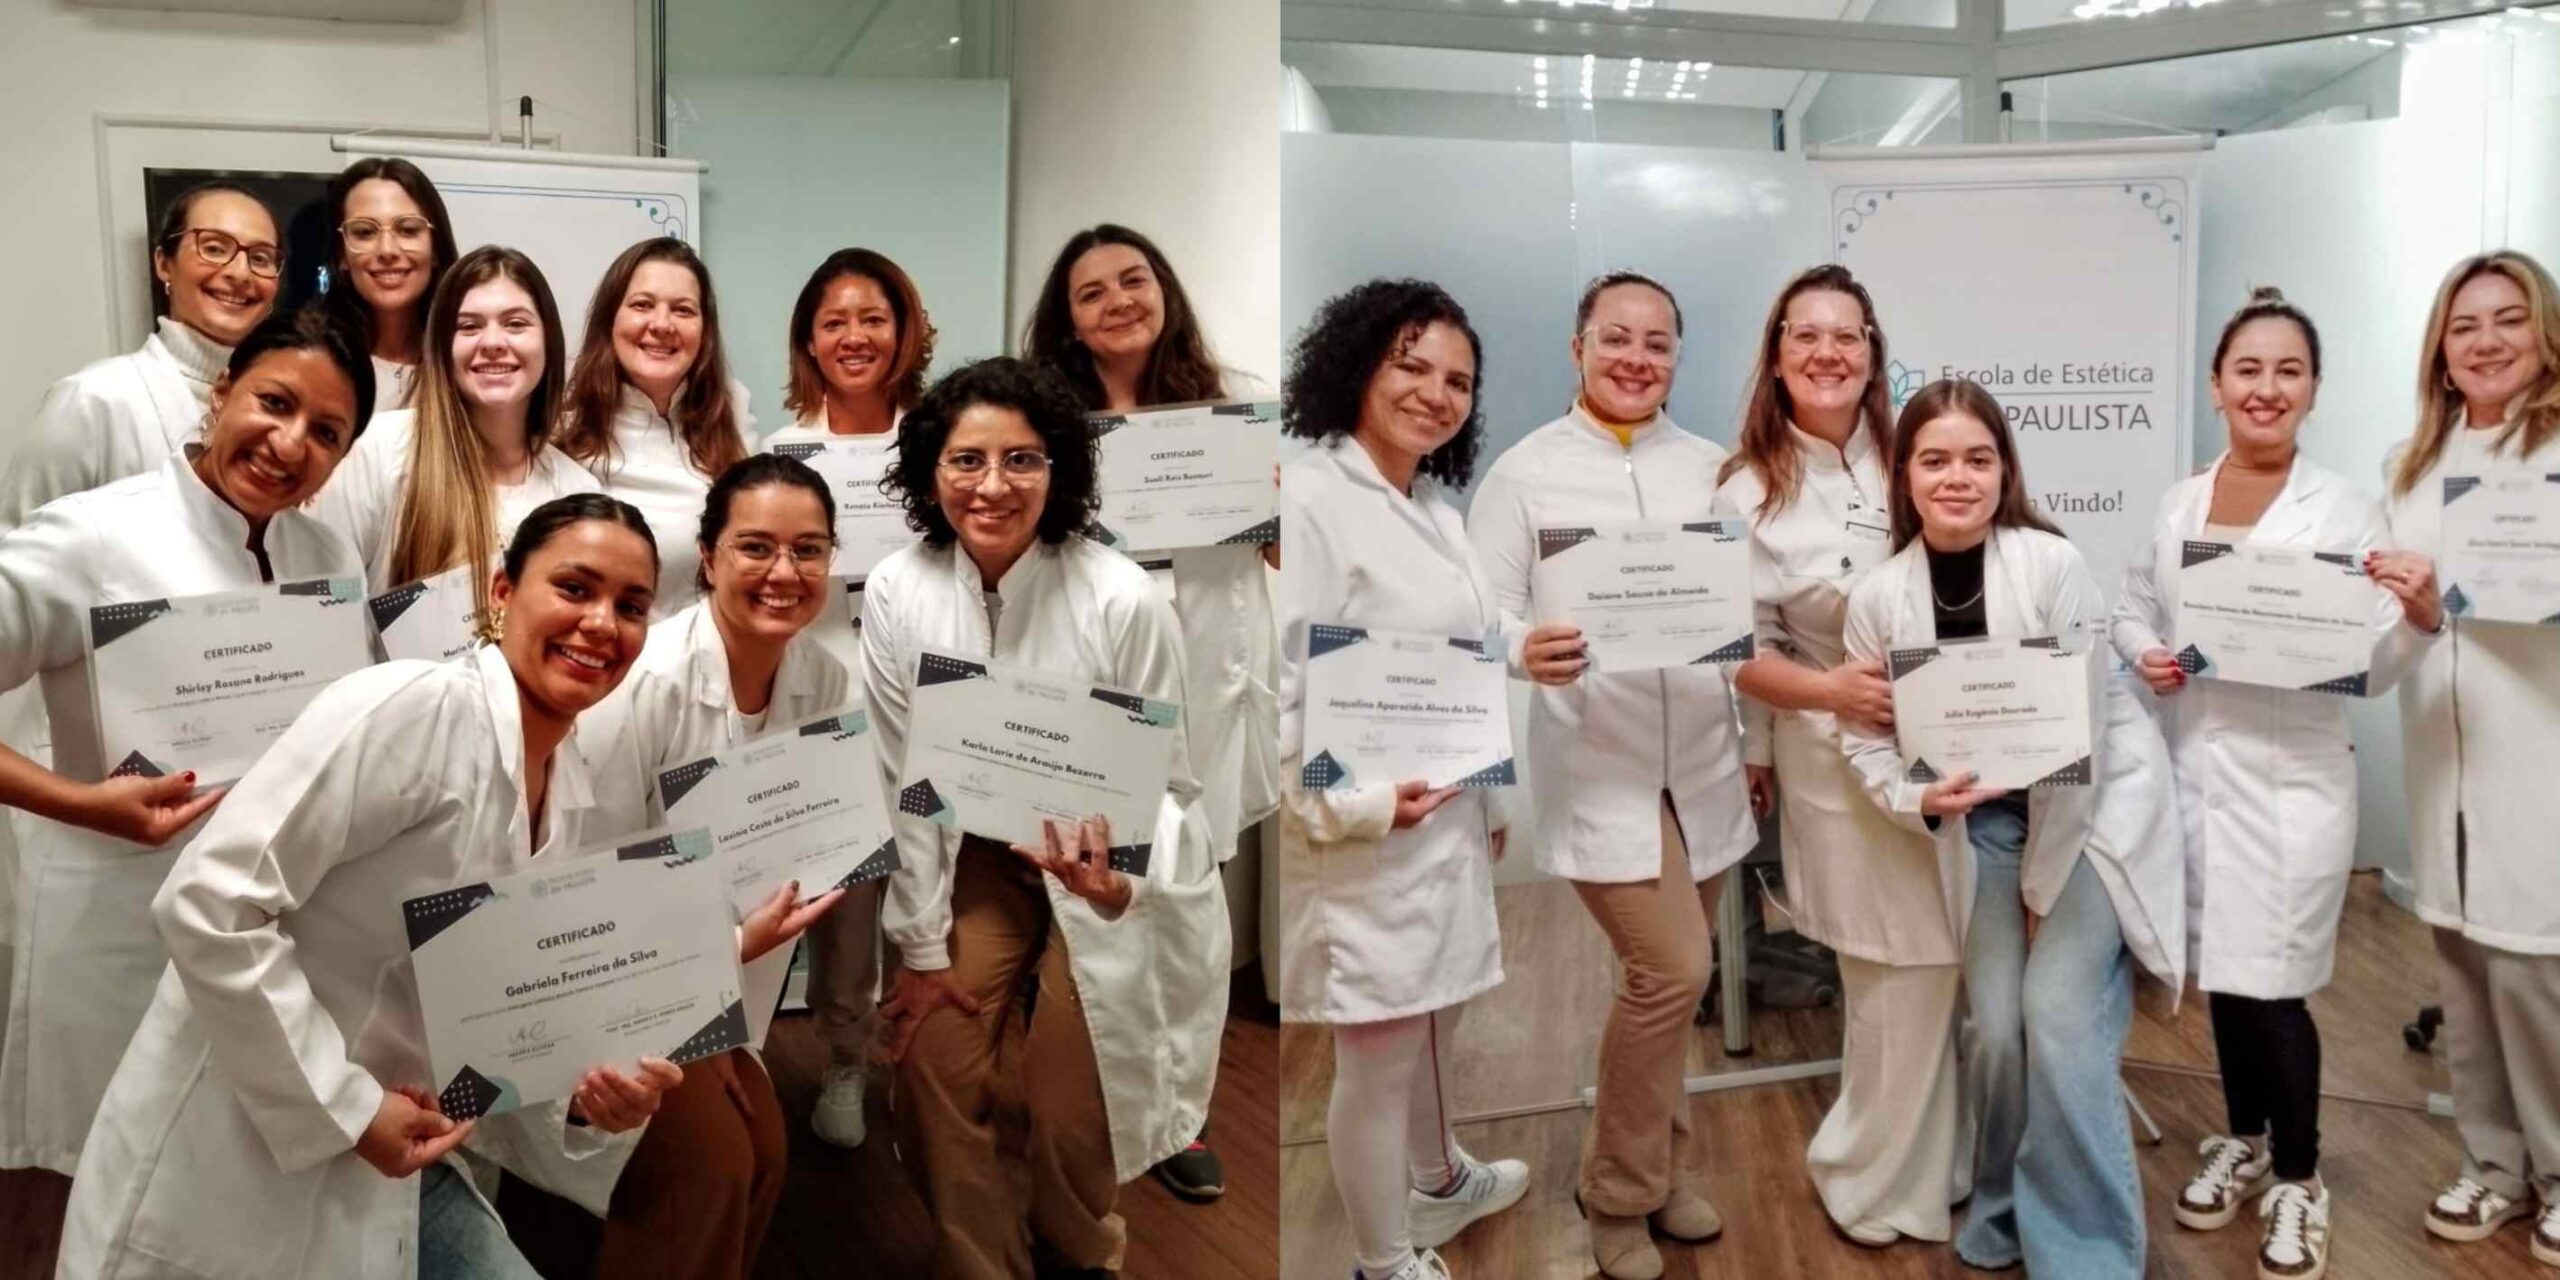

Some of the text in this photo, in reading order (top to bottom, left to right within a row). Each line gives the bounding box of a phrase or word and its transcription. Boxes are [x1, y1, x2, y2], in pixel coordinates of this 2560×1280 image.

[1941, 361, 2154, 385] Escola de Estética
[2005, 404, 2152, 432] PAULISTA
[1150, 449, 1205, 460] CERTIFICADO
[2045, 490, 2123, 513] Vindo!
[1620, 564, 1675, 574] CERTIFICADO
[203, 641, 273, 660] CERTIFICADO
[175, 681, 213, 696] Shirley
[214, 677, 252, 689] Rosane
[254, 669, 305, 683] Rodrigues
[1386, 675, 1438, 686] CERTIFICADO
[1961, 681, 2016, 692] CERTIFICADO
[1465, 704, 1488, 715] Silva
[1004, 720, 1070, 744] CERTIFICADO
[961, 738, 988, 752] Karla
[1015, 752, 1028, 762] de
[1065, 764, 1106, 781] Bezerra
[747, 779, 800, 804] CERTIFICADO
[749, 819, 772, 832] Costa
[773, 814, 784, 825] da
[785, 808, 805, 820] Silva
[805, 797, 840, 813] Ferreira
[536, 921, 616, 951] CERTIFICADO
[505, 975, 559, 997] Gabriela
[561, 963, 610, 983] Ferreira
[612, 957, 627, 969] da
[629, 949, 658, 963] Silva
